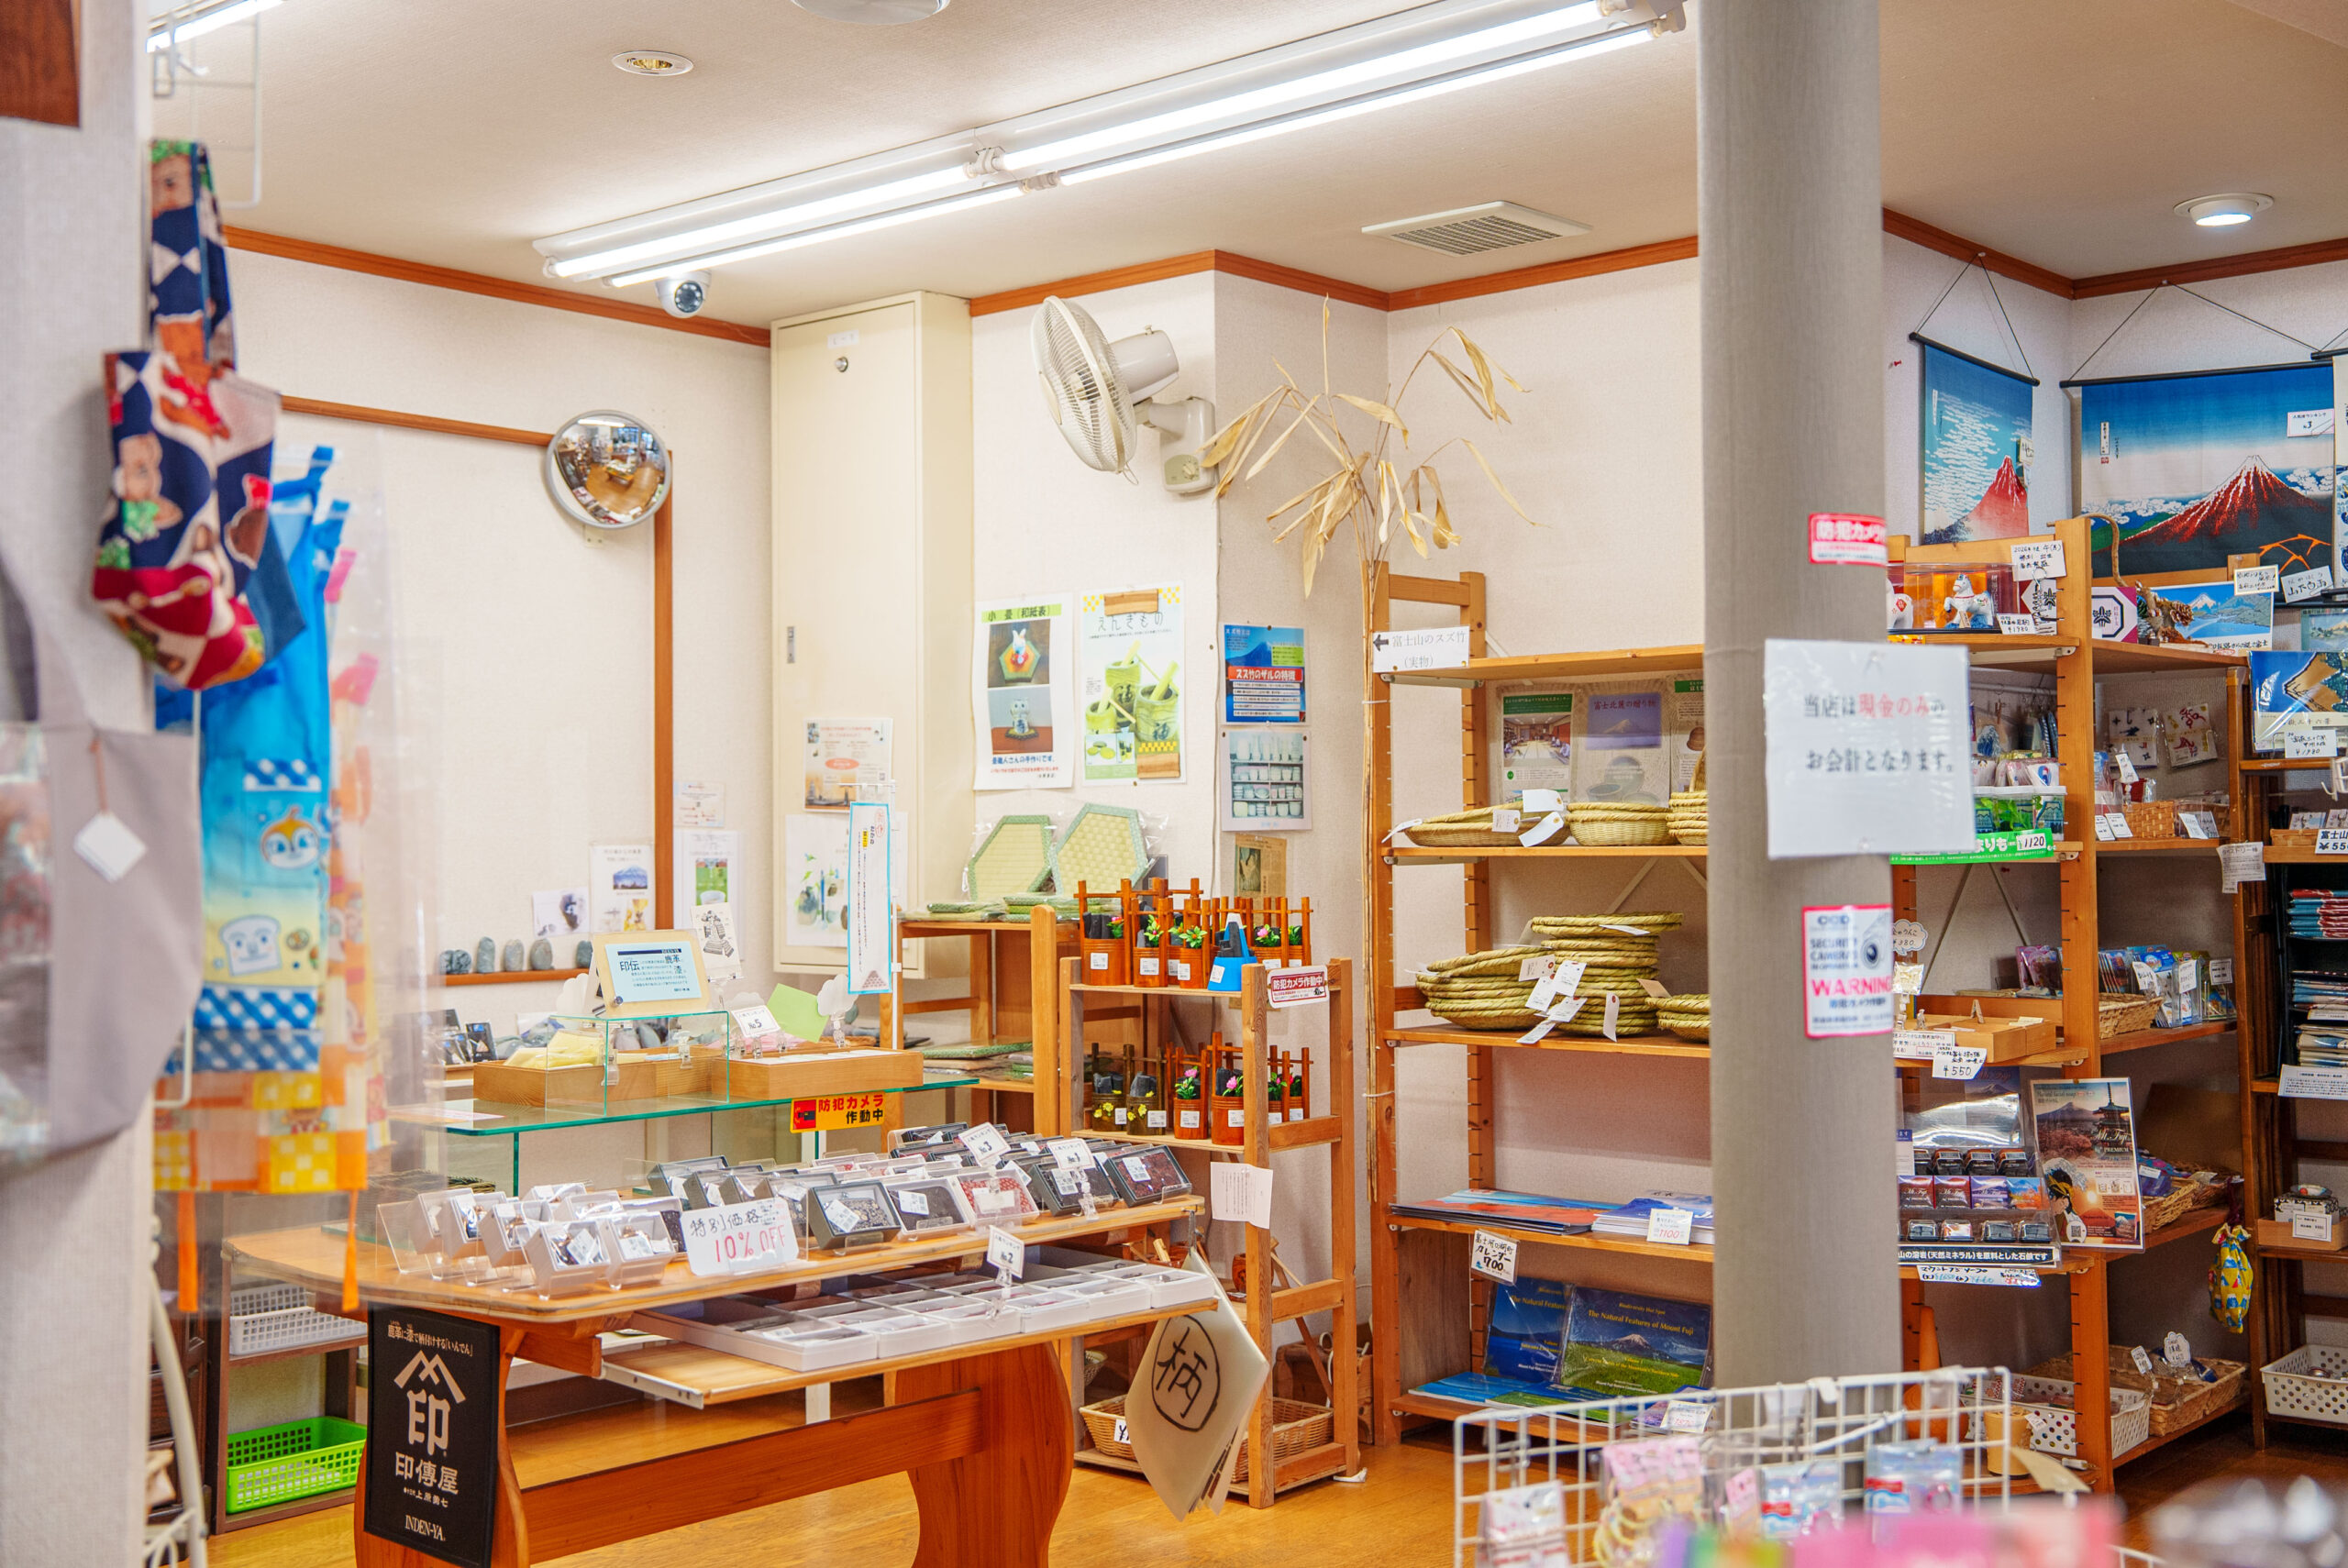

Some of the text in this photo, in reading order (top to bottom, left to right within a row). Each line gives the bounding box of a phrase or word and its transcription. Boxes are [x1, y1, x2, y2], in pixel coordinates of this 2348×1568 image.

[1805, 747, 1954, 774] お会計となります。
[620, 960, 640, 972] 印伝
[1273, 975, 1323, 990] 防犯カメラ作動中
[1943, 1064, 1972, 1077] ¥550
[818, 1094, 884, 1113] 防犯カメラ
[846, 1108, 884, 1124] 作動中
[690, 1208, 763, 1238] 特別価格
[715, 1223, 787, 1264] 10% OFF
[1475, 1245, 1512, 1263] カレンダー
[1483, 1256, 1504, 1271] 700
[1589, 1309, 1694, 1336] The Natural Features of Mount Fuji
[395, 1451, 459, 1495] 印傳屋
